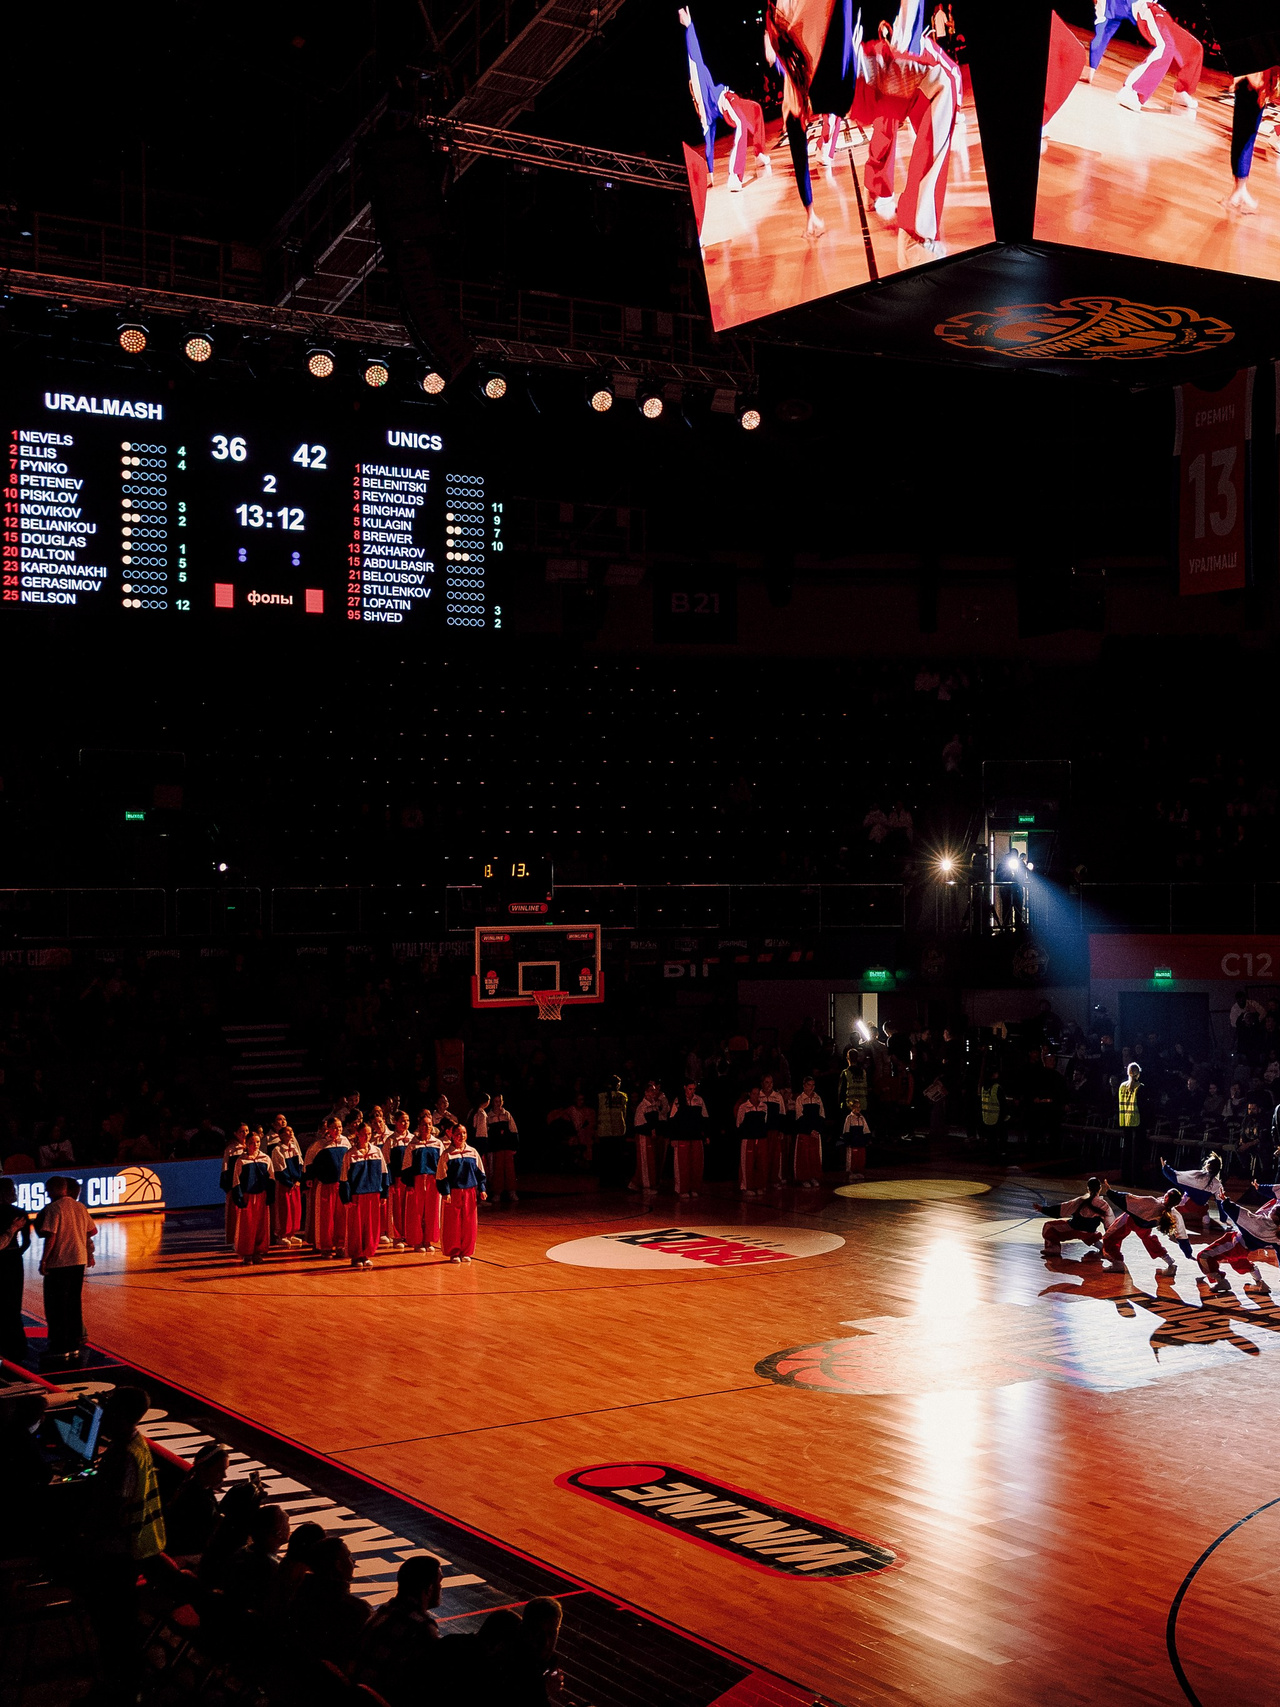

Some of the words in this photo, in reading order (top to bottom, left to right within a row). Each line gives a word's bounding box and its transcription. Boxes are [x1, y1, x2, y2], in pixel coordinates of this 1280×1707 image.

[45, 393, 162, 420] URALMASH
[11, 430, 18, 440] 1
[19, 431, 74, 446] NEVELS
[387, 430, 443, 450] UNICS
[10, 445, 18, 455] 2
[20, 446, 57, 459] ELLIS
[177, 446, 187, 457] 4
[211, 435, 248, 462] 36
[293, 444, 328, 470] 42
[10, 460, 18, 469] 7
[20, 460, 68, 474] PYNKO
[177, 460, 187, 471] 4
[355, 464, 360, 474] 1
[362, 464, 430, 481] KHALILULAE
[10, 474, 18, 484] 8
[20, 475, 83, 490] PETENEV
[263, 474, 277, 493] 2
[353, 477, 360, 486] 2
[362, 477, 427, 494] BELENITSKI
[3, 488, 18, 498] 10
[20, 489, 78, 504] PISKLOV
[353, 490, 360, 500] 3
[362, 490, 424, 506] REYNOLDS
[1188, 446, 1237, 539] 13
[4, 503, 18, 513] 11
[20, 504, 81, 518] NOVIKOV
[178, 502, 187, 513] 3
[353, 504, 360, 514] 4
[362, 504, 416, 520] BINGHAM
[491, 502, 503, 513] 11
[178, 516, 187, 527] 2
[236, 504, 305, 531] 13:12
[353, 517, 360, 527] 5
[362, 517, 412, 532] KULAGIN
[493, 515, 501, 526] 9
[4, 518, 18, 528] 12
[20, 518, 96, 534] BELIANKOU
[494, 528, 500, 538] 7
[4, 532, 18, 542] 15
[21, 532, 86, 548] DOUGLAS
[353, 530, 360, 540] 8
[362, 530, 413, 545] BREWER
[3, 546, 18, 557] 20
[21, 547, 75, 562] DALTON
[179, 544, 186, 554] 1
[348, 544, 360, 554] 13
[363, 544, 426, 559] ZAKHAROV
[491, 541, 504, 552] 10
[3, 561, 18, 572] 23
[21, 562, 107, 578] KARDANAKHI
[178, 558, 187, 569] 5
[348, 557, 360, 567] 15
[363, 558, 435, 573] ABDULBASIR
[1188, 551, 1237, 575] УРАЛМАШ
[3, 576, 18, 586] 24
[21, 576, 102, 592] GERASIMOV
[178, 572, 187, 583] 5
[348, 570, 360, 580] 21
[363, 570, 425, 586] BELOUSOV
[3, 590, 18, 600] 25
[21, 591, 76, 604] NELSON
[247, 590, 294, 606] фолы
[348, 584, 360, 594] 22
[363, 584, 431, 600] STULENKOV
[176, 600, 190, 611] 12
[348, 598, 360, 608] 27
[363, 598, 411, 612] LOPATIN
[494, 606, 501, 616] 3
[348, 610, 360, 620] 95
[363, 611, 403, 624] SHVED
[494, 618, 501, 629] 2
[1221, 953, 1273, 977] C12
[87, 1175, 127, 1206] CUP
[610, 1481, 870, 1571] WINLINE
